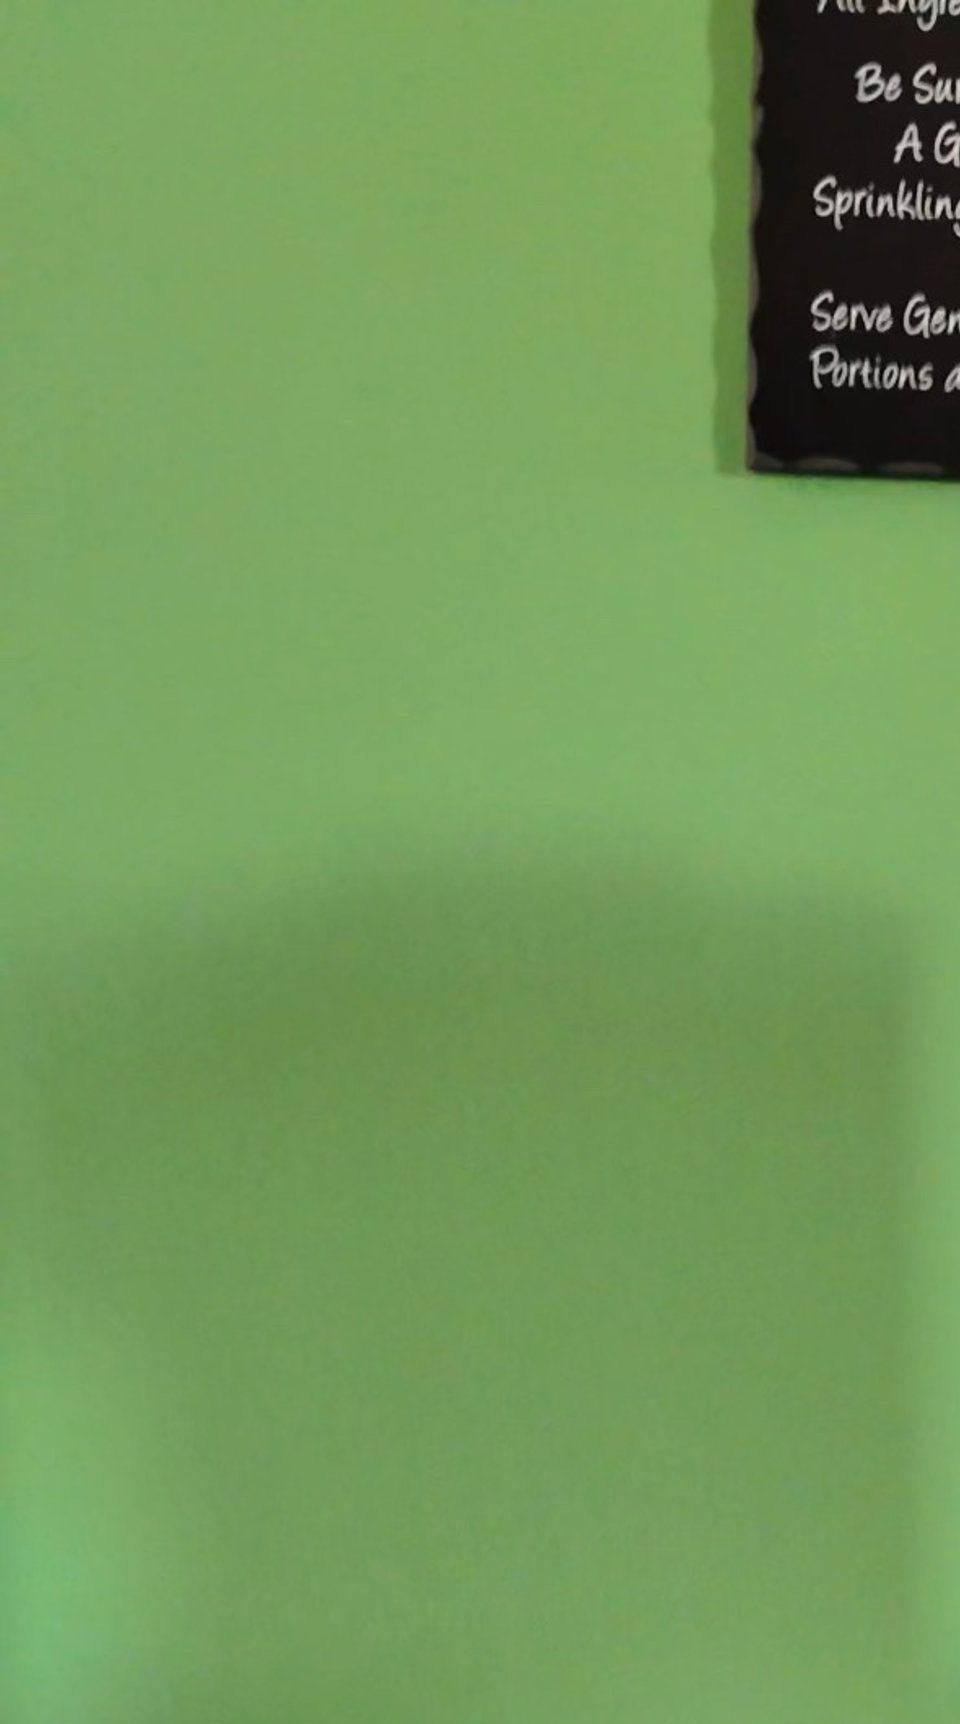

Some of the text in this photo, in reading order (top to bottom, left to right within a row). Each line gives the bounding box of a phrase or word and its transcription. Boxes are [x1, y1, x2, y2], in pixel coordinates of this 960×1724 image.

[854, 62, 903, 104] Be
[893, 122, 924, 164] A
[810, 290, 894, 333] Serve
[809, 345, 934, 391] Portions
